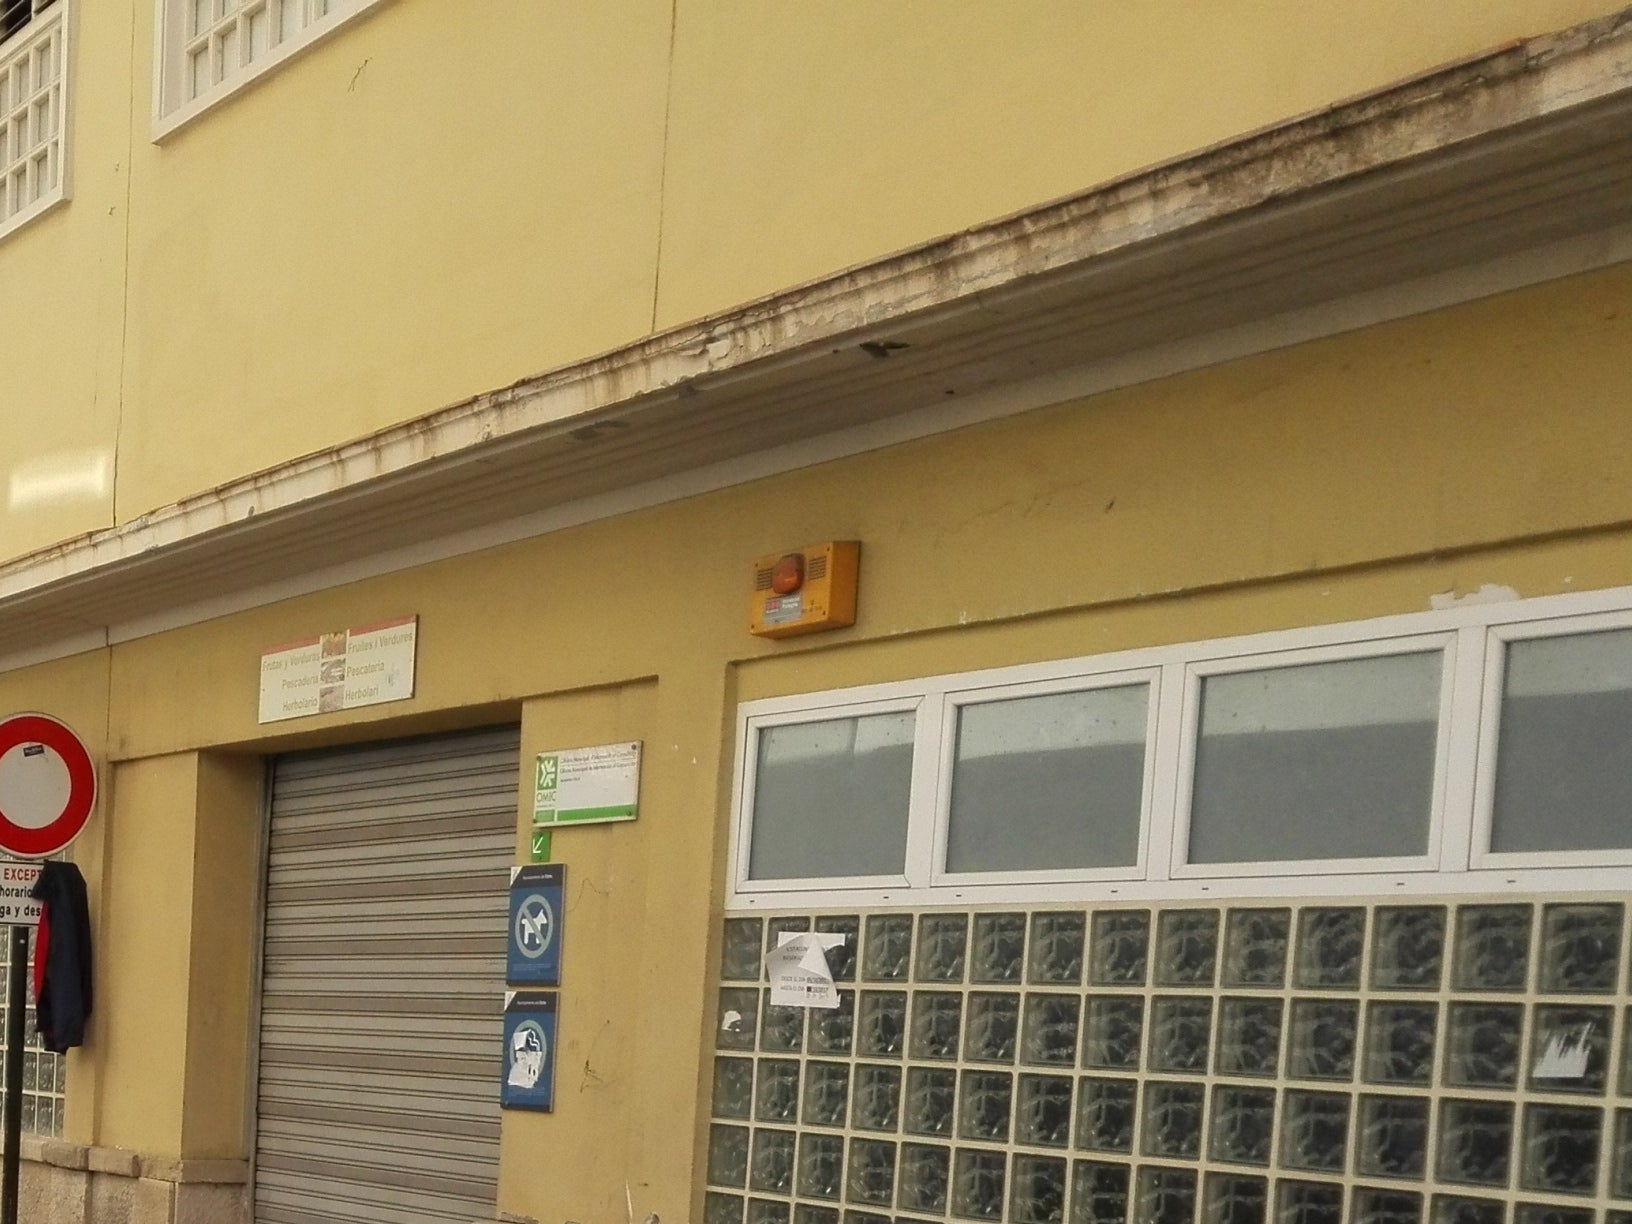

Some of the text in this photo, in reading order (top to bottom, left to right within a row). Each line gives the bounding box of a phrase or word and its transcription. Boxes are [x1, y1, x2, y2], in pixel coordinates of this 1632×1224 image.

[536, 791, 557, 803] OMIC
[0, 885, 33, 898] horario
[15, 906, 21, 918] y
